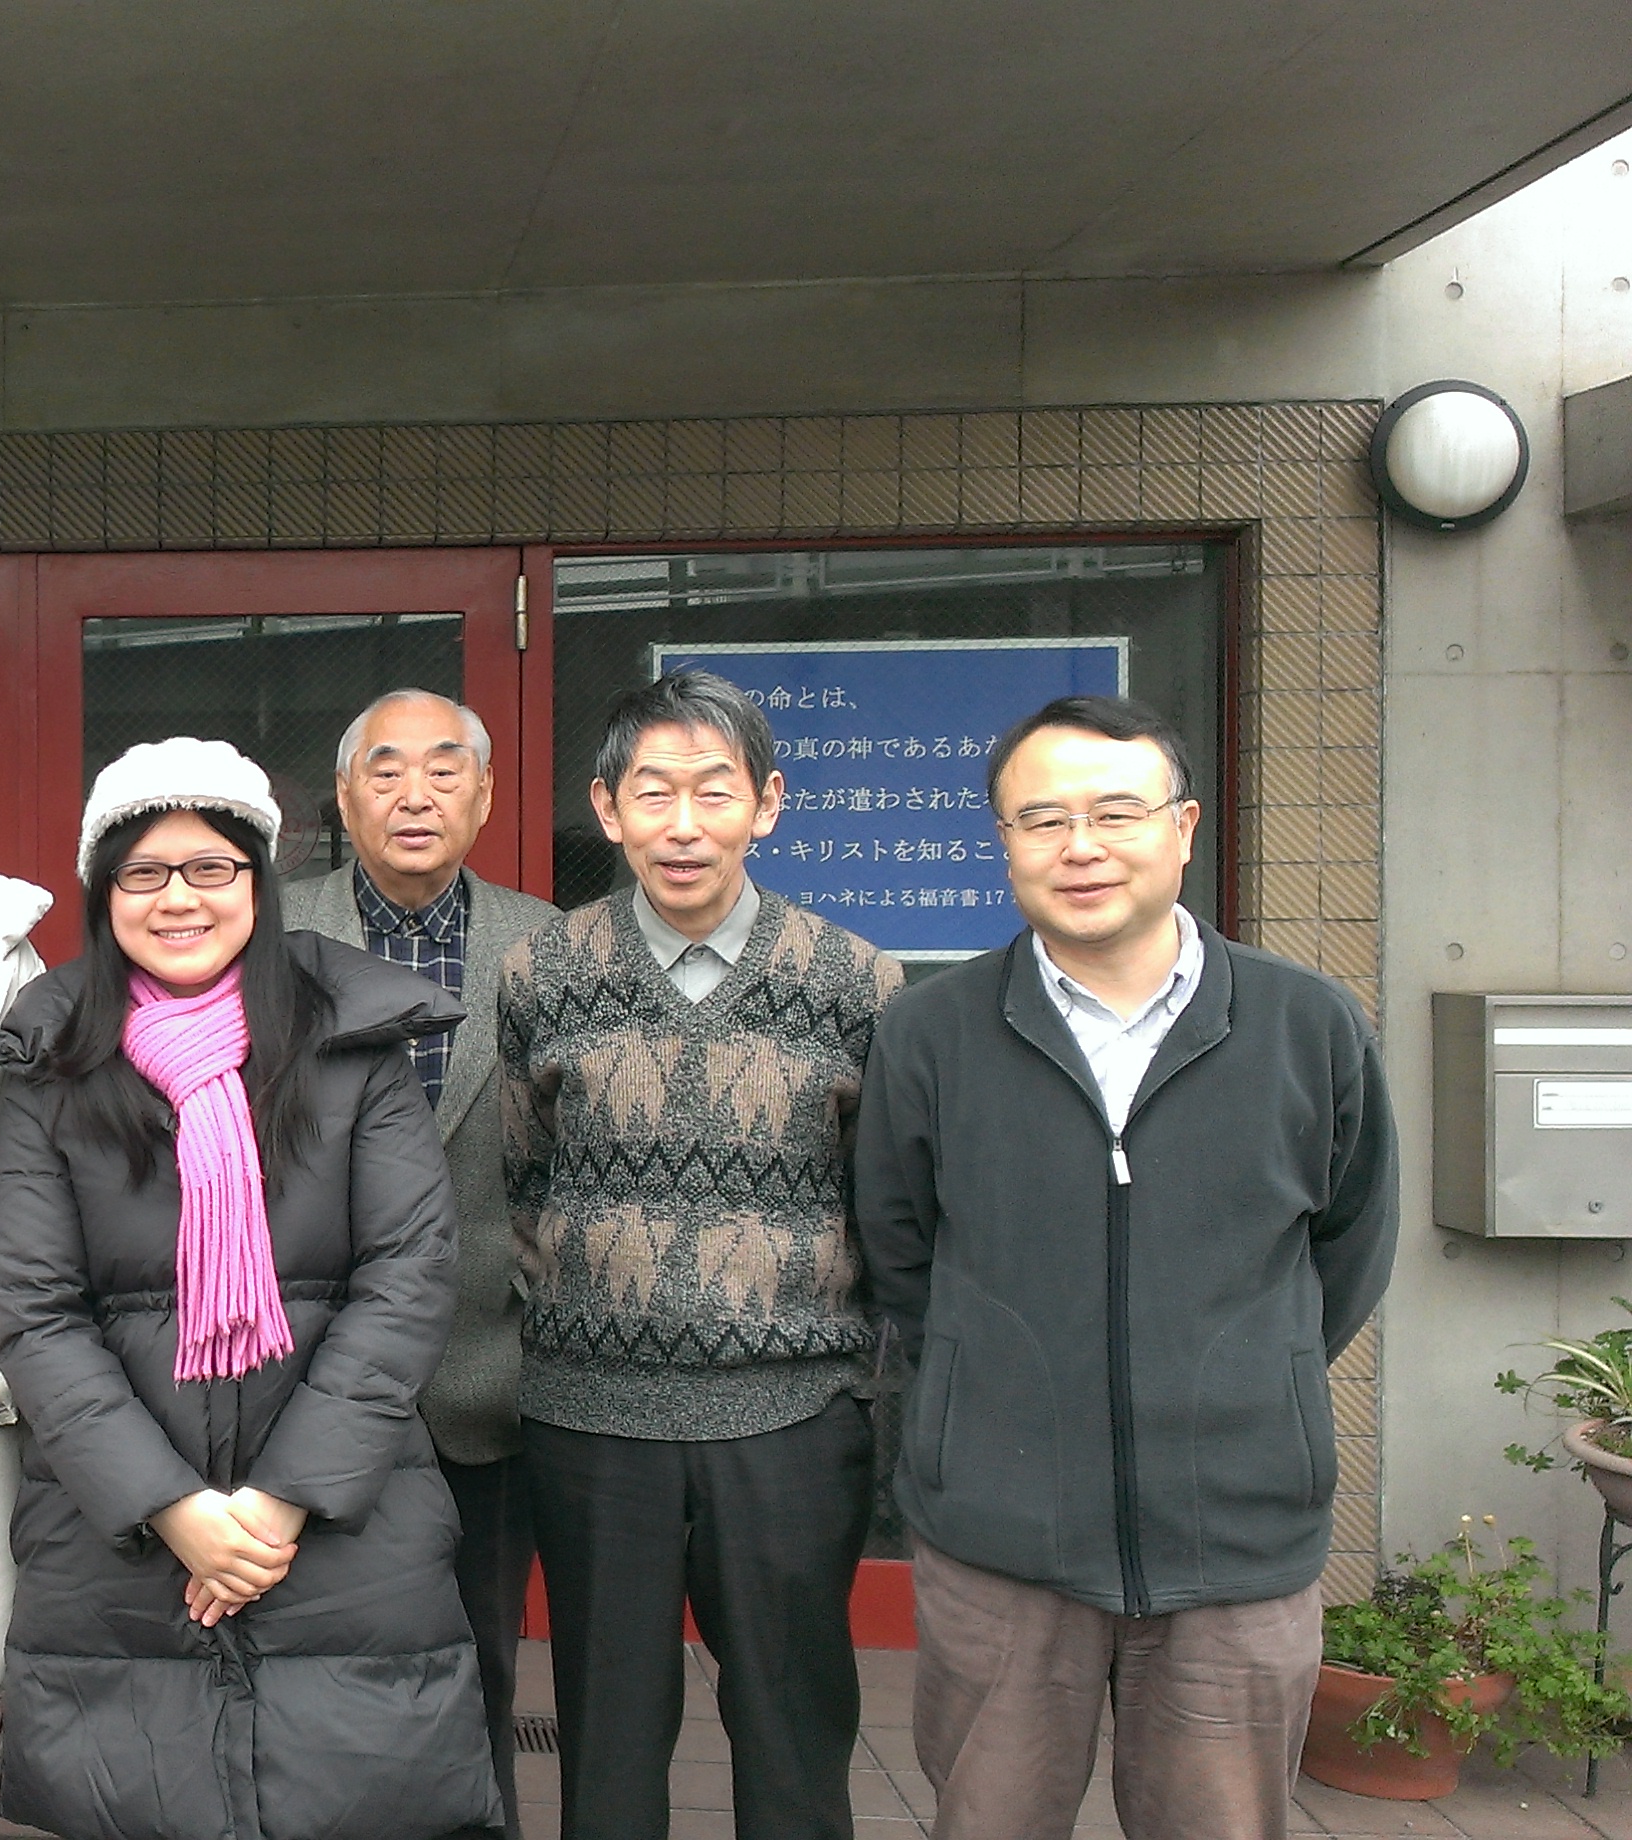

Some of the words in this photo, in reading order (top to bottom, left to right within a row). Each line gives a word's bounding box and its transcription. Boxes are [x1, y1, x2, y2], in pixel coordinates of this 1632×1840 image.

[744, 686, 858, 710] の命とは、
[777, 787, 990, 812] なたが遣わされた
